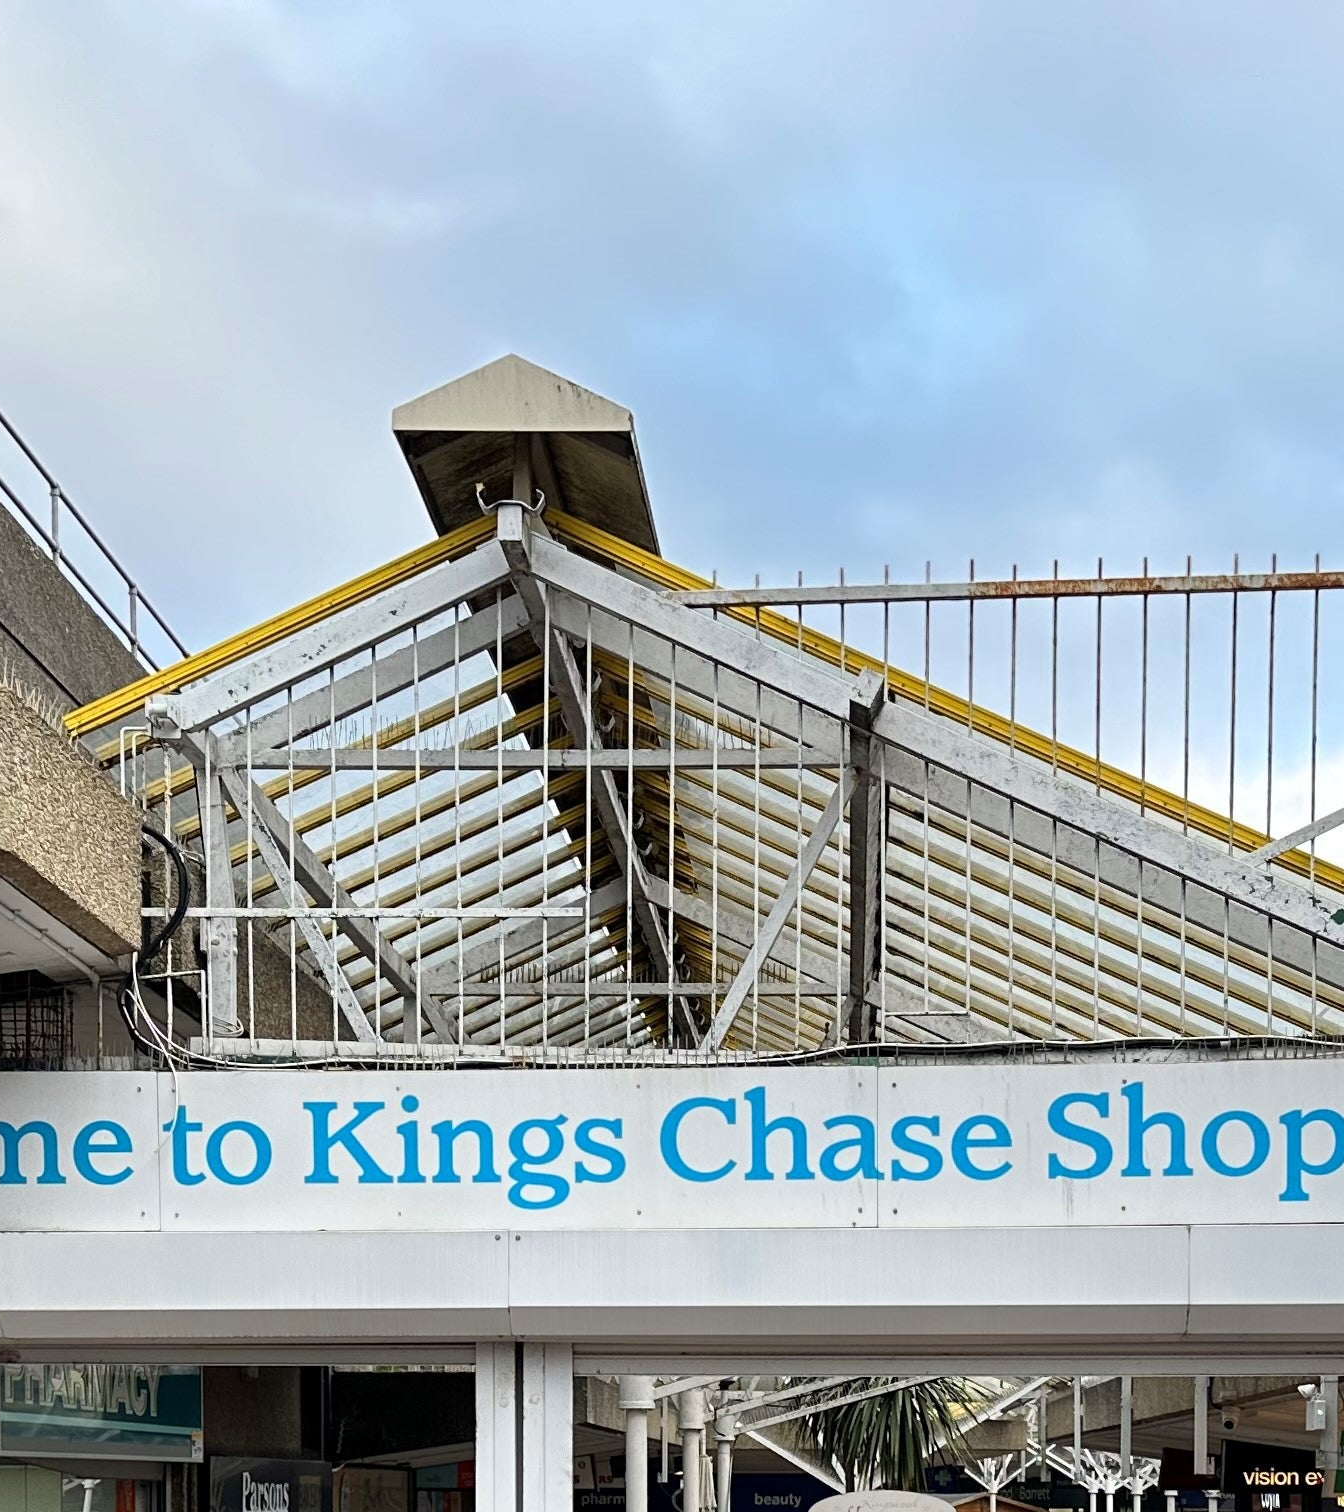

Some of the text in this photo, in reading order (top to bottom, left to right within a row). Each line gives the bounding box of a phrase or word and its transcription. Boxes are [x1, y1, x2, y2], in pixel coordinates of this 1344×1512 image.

[163, 1104, 273, 1187] to
[303, 1094, 626, 1210] Kings
[659, 1086, 1013, 1184] Chase
[5, 1364, 159, 1417] PHARMACY
[242, 1472, 290, 1512] Parsons
[1243, 1467, 1299, 1486] vision
[754, 1493, 802, 1509] beauty
